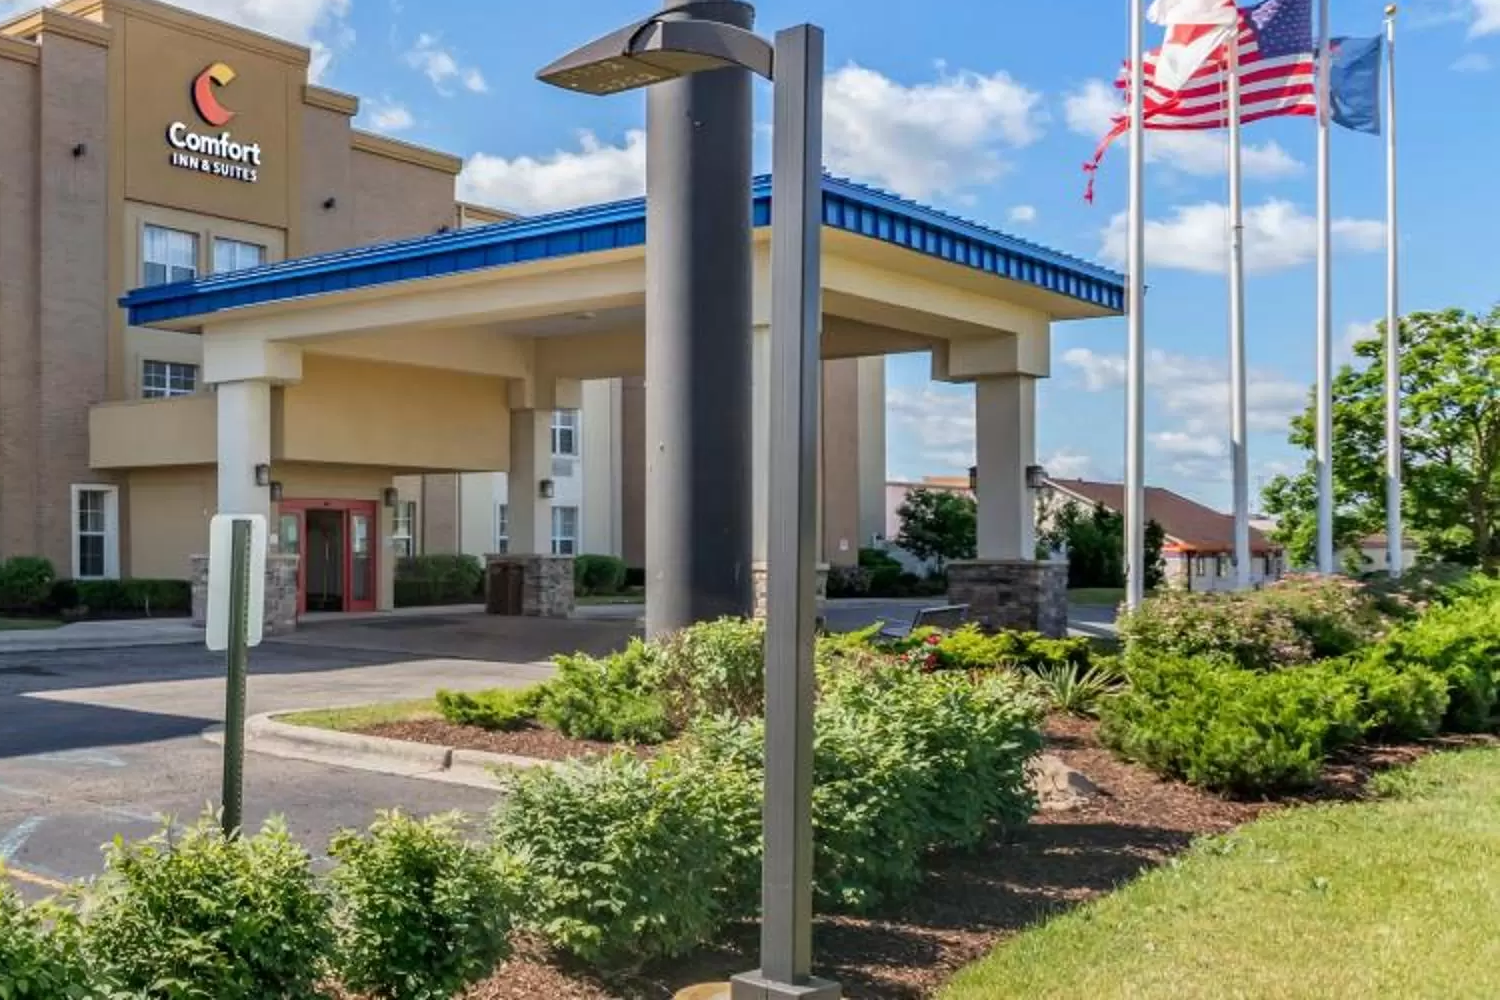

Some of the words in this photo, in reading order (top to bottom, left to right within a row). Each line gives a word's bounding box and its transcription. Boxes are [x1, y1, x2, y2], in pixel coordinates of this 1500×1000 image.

[169, 121, 261, 165] Comfort
[172, 153, 199, 169] INN
[201, 158, 211, 172] &
[213, 161, 258, 182] SUITES
